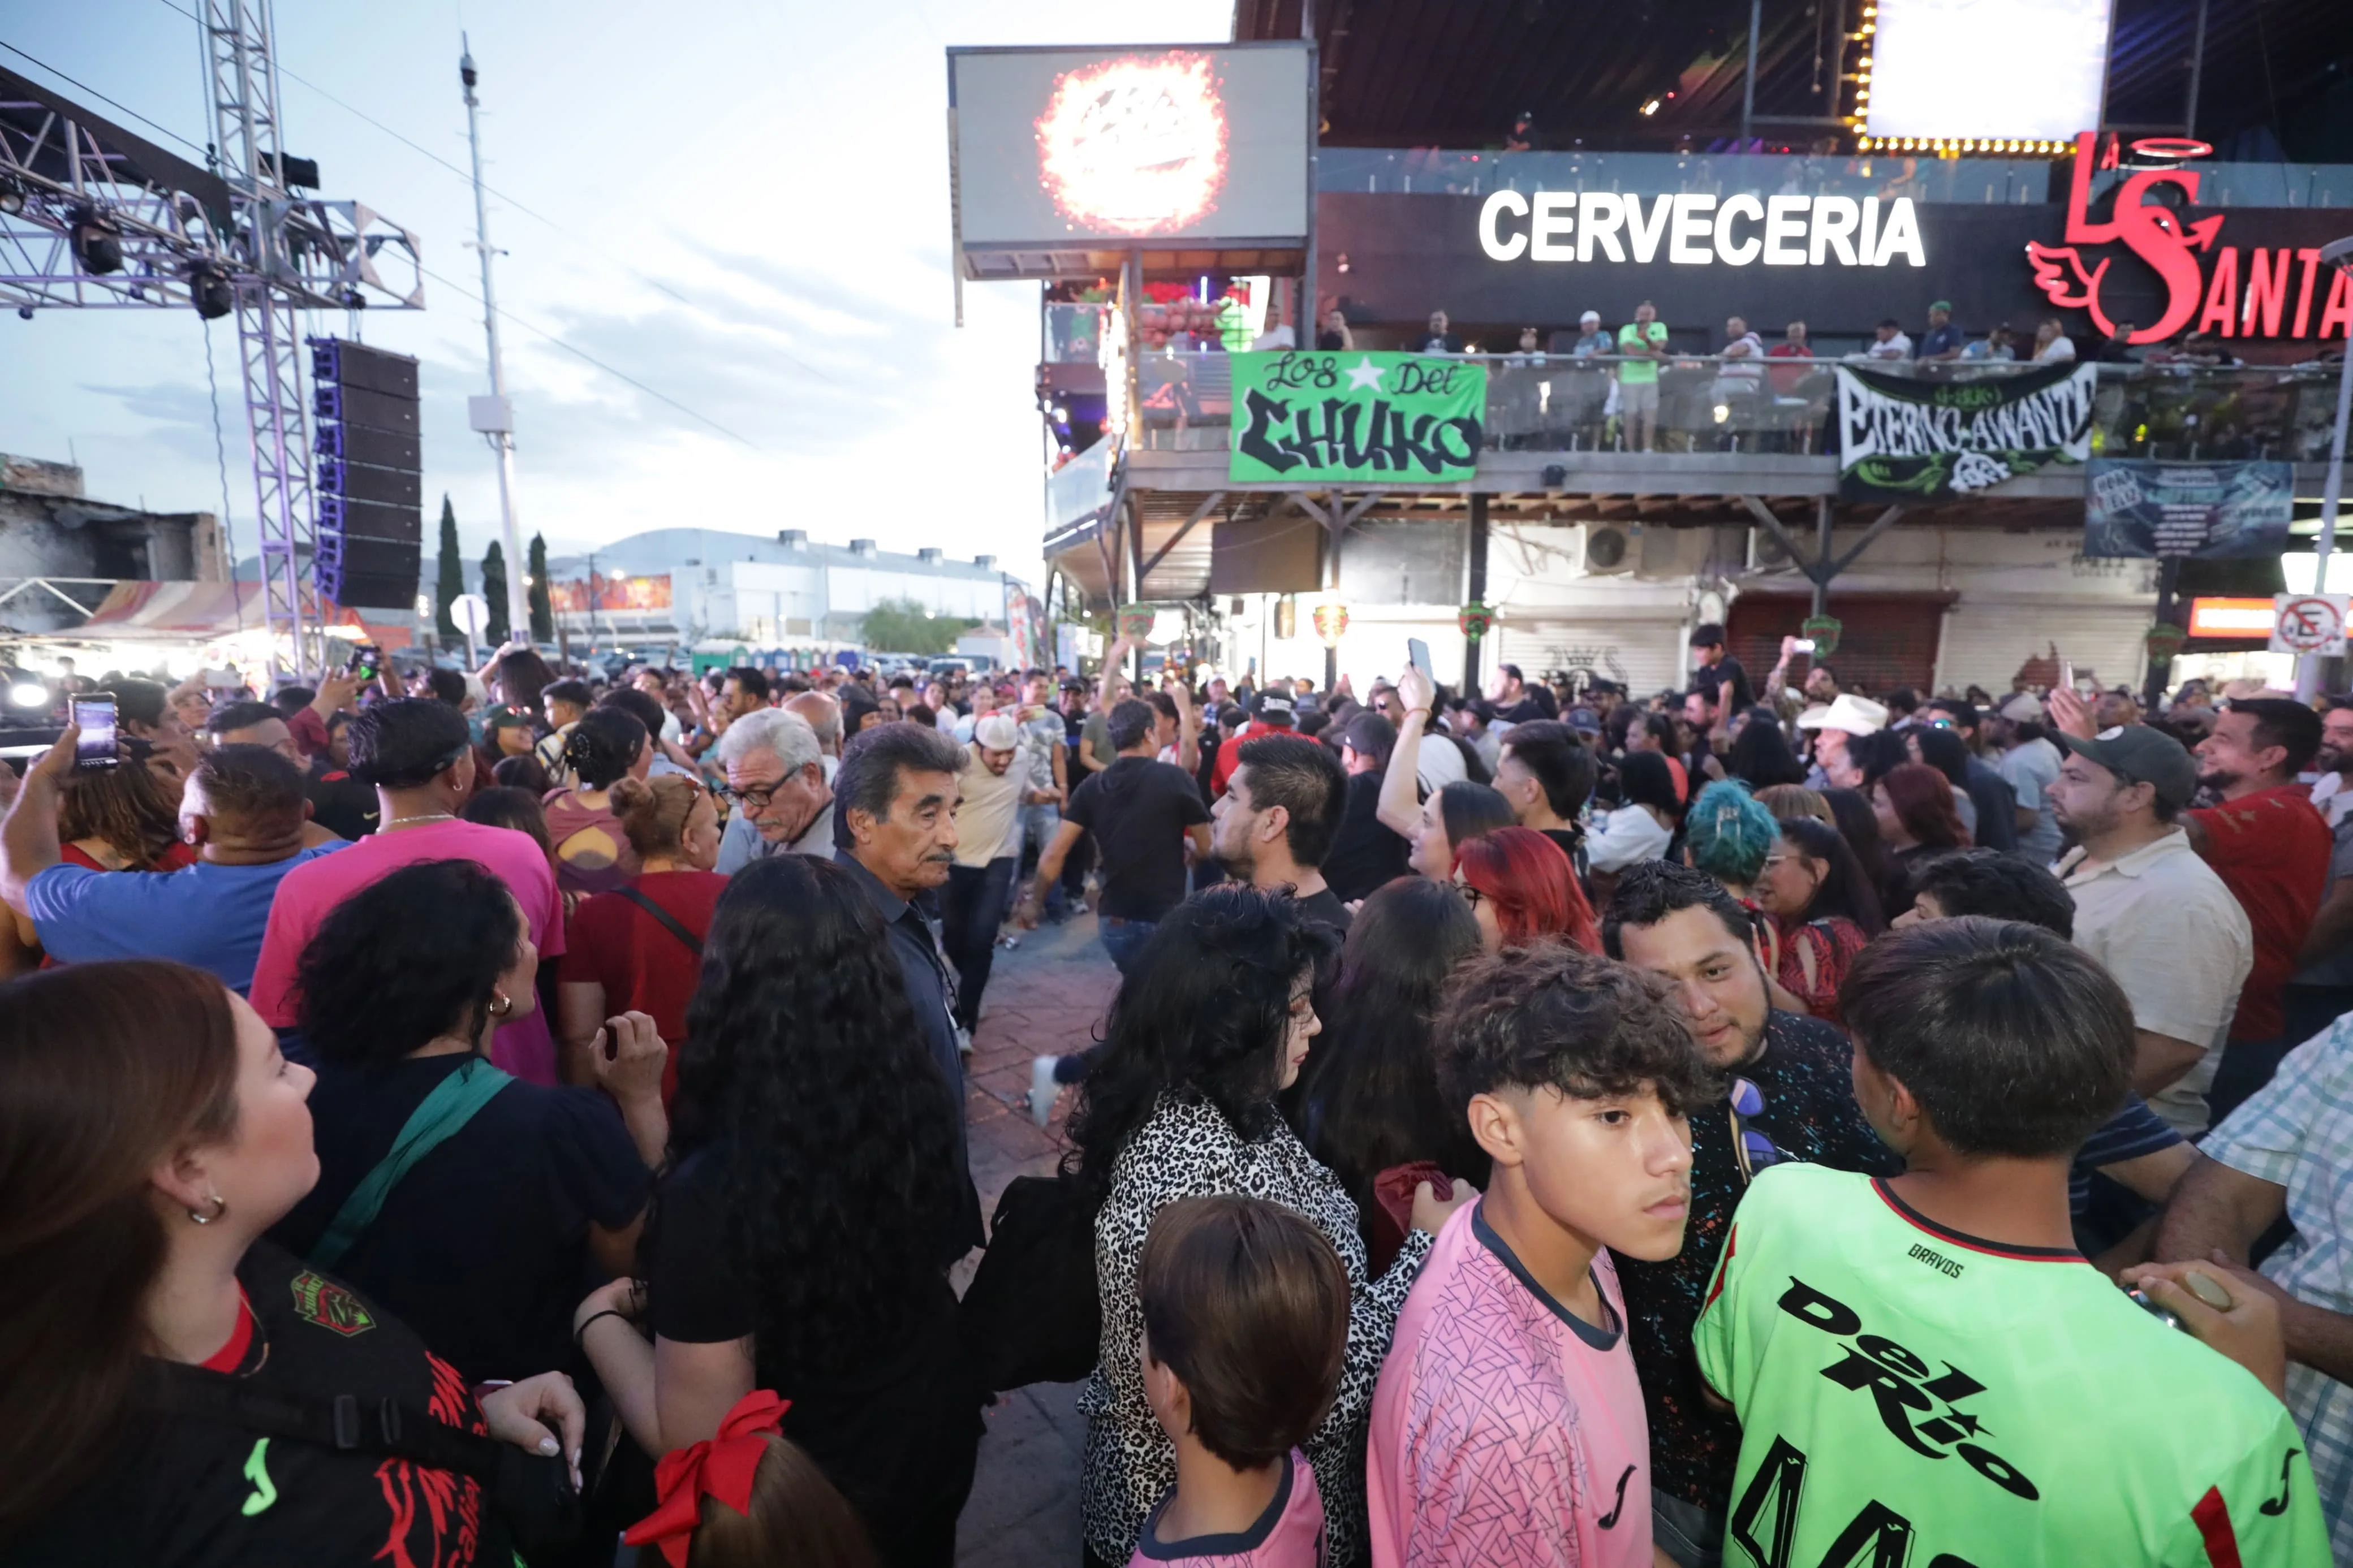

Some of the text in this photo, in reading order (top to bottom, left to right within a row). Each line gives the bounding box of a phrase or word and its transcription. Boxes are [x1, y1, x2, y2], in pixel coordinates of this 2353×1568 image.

[1479, 189, 1926, 267] CERVECERIA
[1238, 387, 1483, 474] CHUKO
[1835, 365, 1962, 470] ETERNO
[1908, 1243, 1964, 1280] BRAVOS
